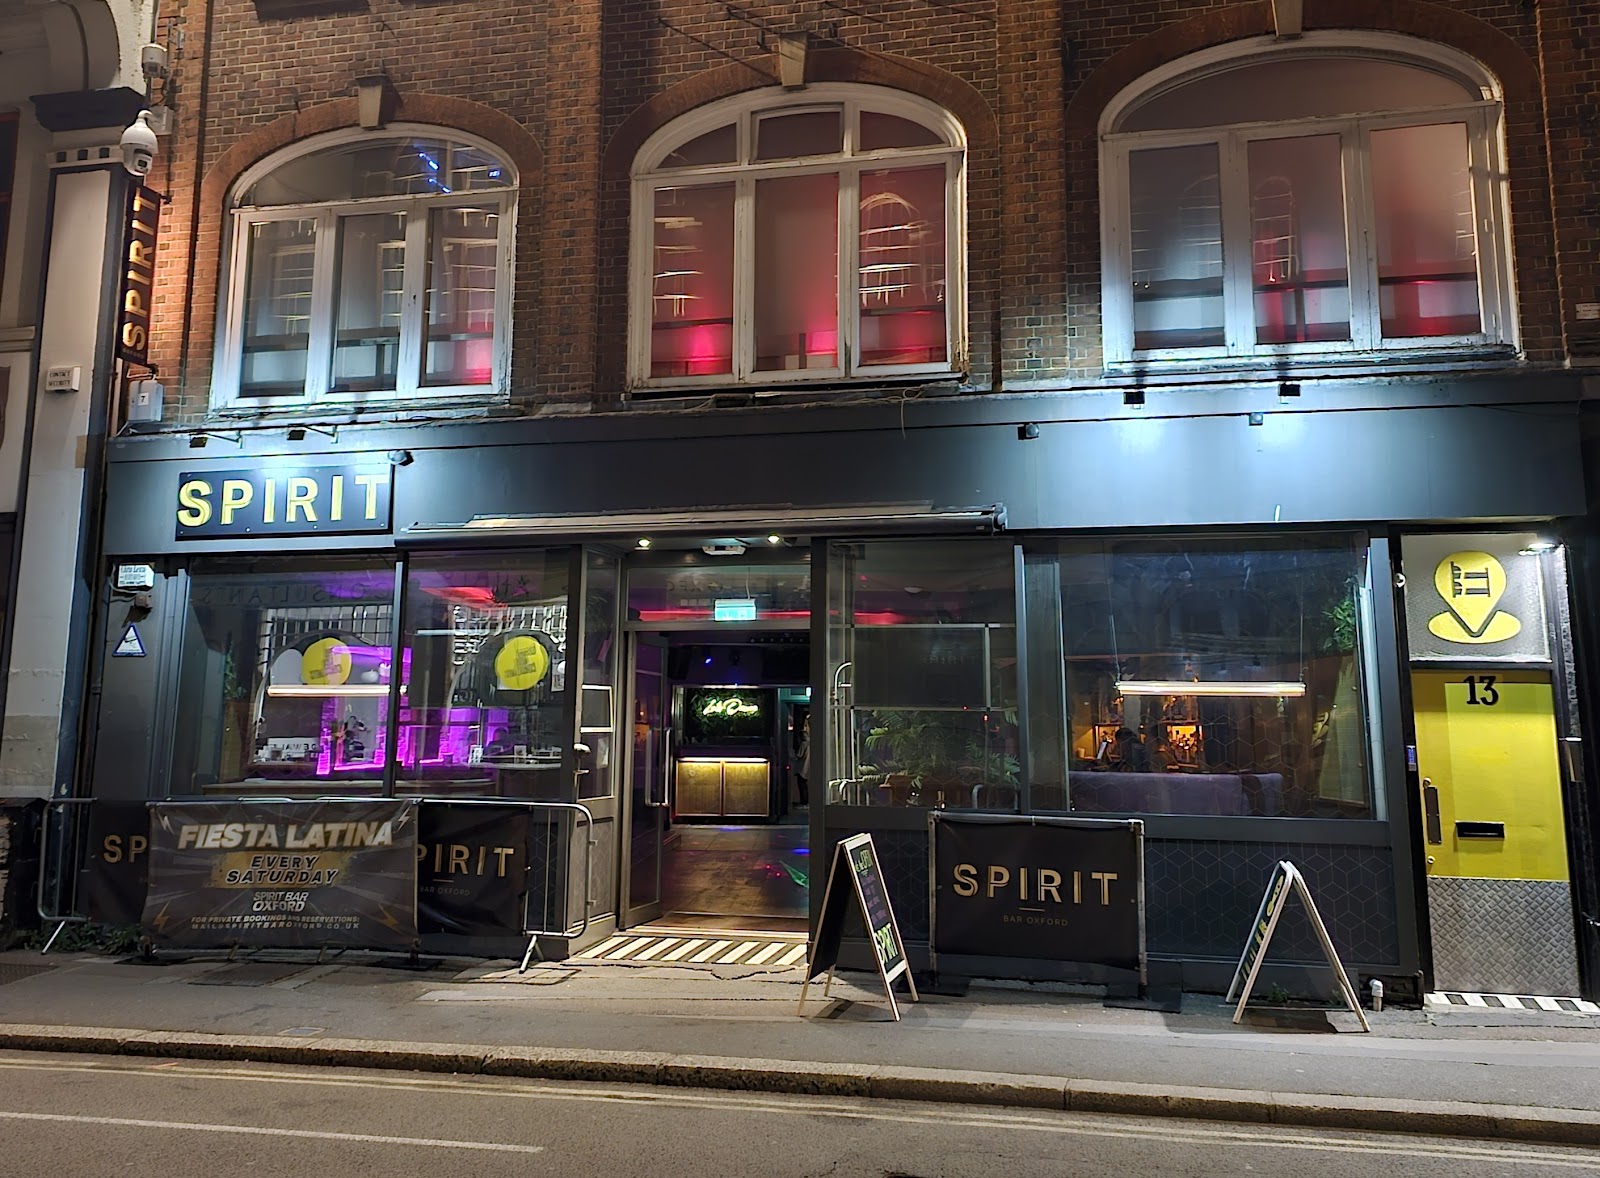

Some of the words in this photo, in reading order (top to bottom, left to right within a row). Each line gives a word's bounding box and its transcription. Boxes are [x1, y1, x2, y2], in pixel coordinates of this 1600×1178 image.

[122, 187, 156, 351] SPIRIT
[140, 395, 146, 403] 7
[176, 475, 388, 527] SPIRIT
[1463, 675, 1499, 706] 13
[177, 823, 279, 850] FIESTA
[285, 820, 393, 849] LATINA
[251, 854, 319, 871] EVERY
[225, 868, 339, 885] SATURDAY
[953, 863, 1118, 906] SPIRIT
[253, 892, 286, 901] SPIRIT
[284, 891, 309, 902] BAR
[437, 887, 470, 897] OXFORD
[252, 900, 305, 912] OXFORD
[243, 914, 287, 922] BOOKINGS
[1003, 914, 1023, 924] BAR
[1026, 916, 1069, 927] OXFORD
